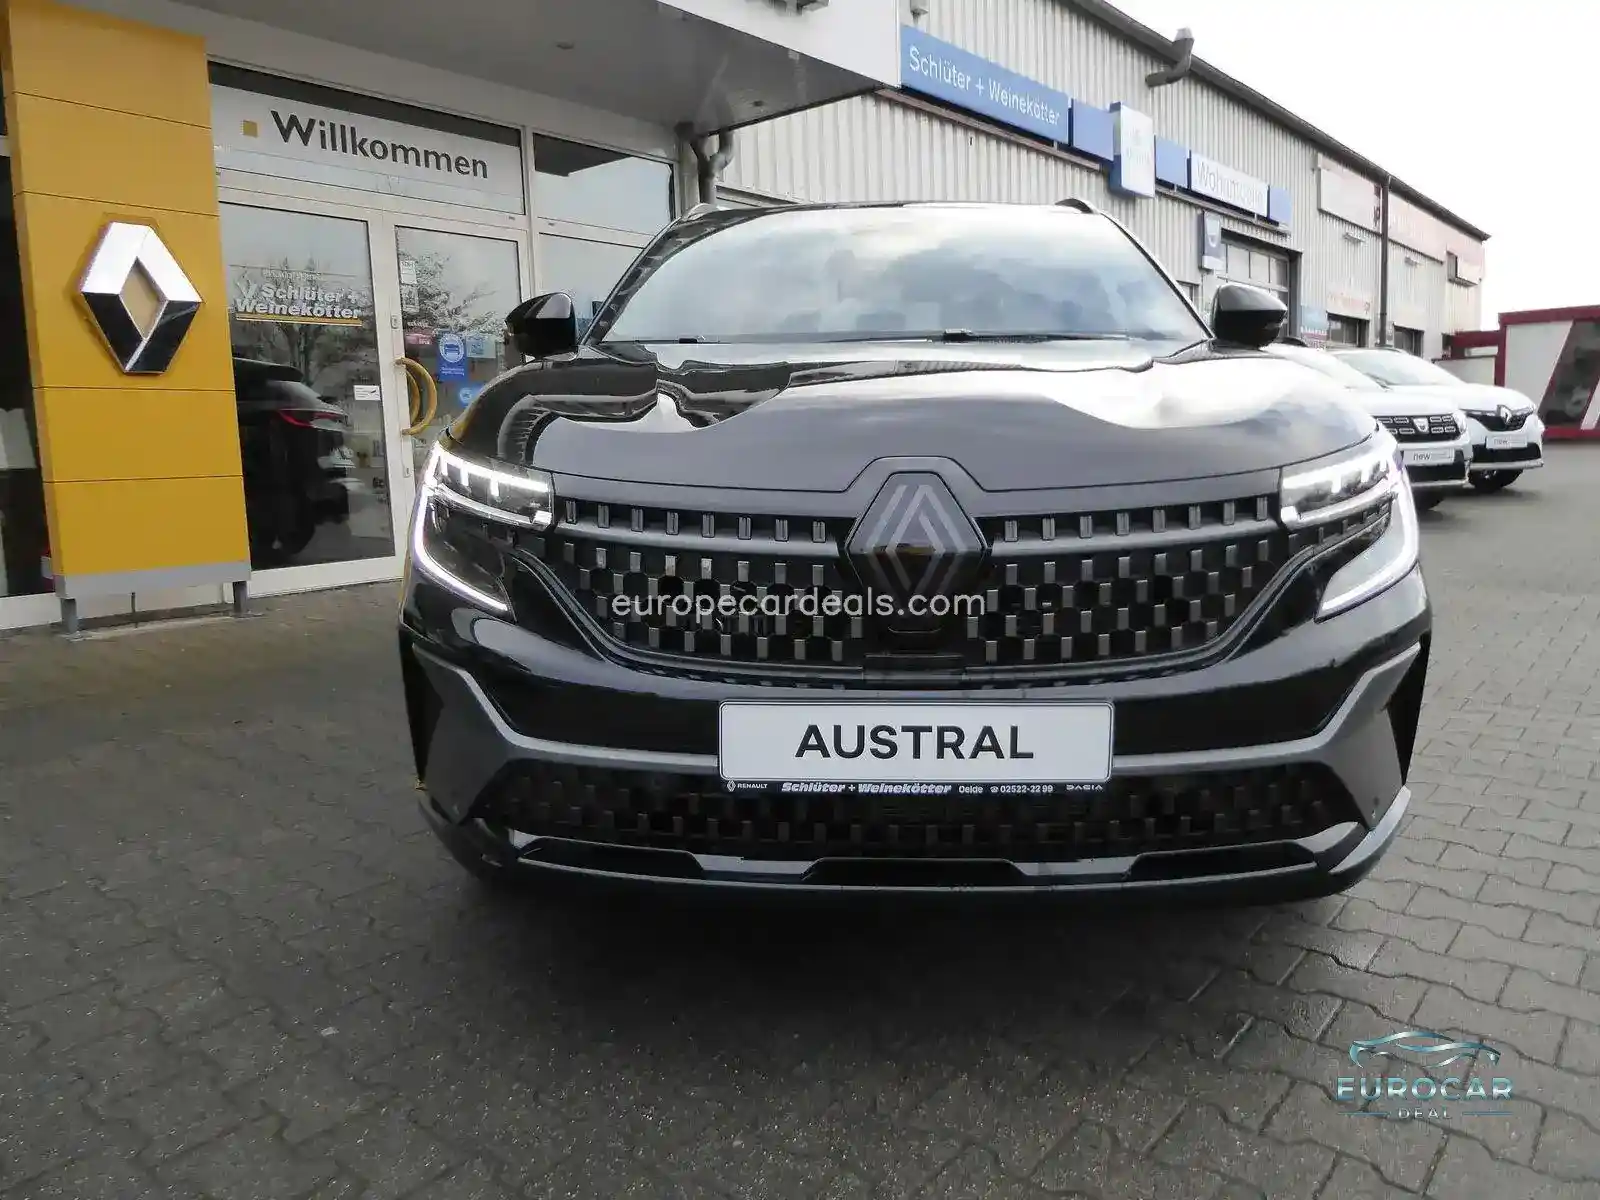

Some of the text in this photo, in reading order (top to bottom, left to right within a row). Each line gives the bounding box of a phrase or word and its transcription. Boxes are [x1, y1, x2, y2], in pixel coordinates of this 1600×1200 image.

[909, 46, 971, 92] Schlüter
[988, 80, 1061, 126] Weinekötter
[270, 110, 488, 179] Willkommen
[261, 281, 344, 303] Schlüter
[236, 298, 362, 319] Weinekötter
[1413, 452, 1431, 461] new
[794, 723, 1034, 760] AUSTRAL
[781, 781, 846, 793] Schlüter
[857, 781, 952, 794] Weinekötter
